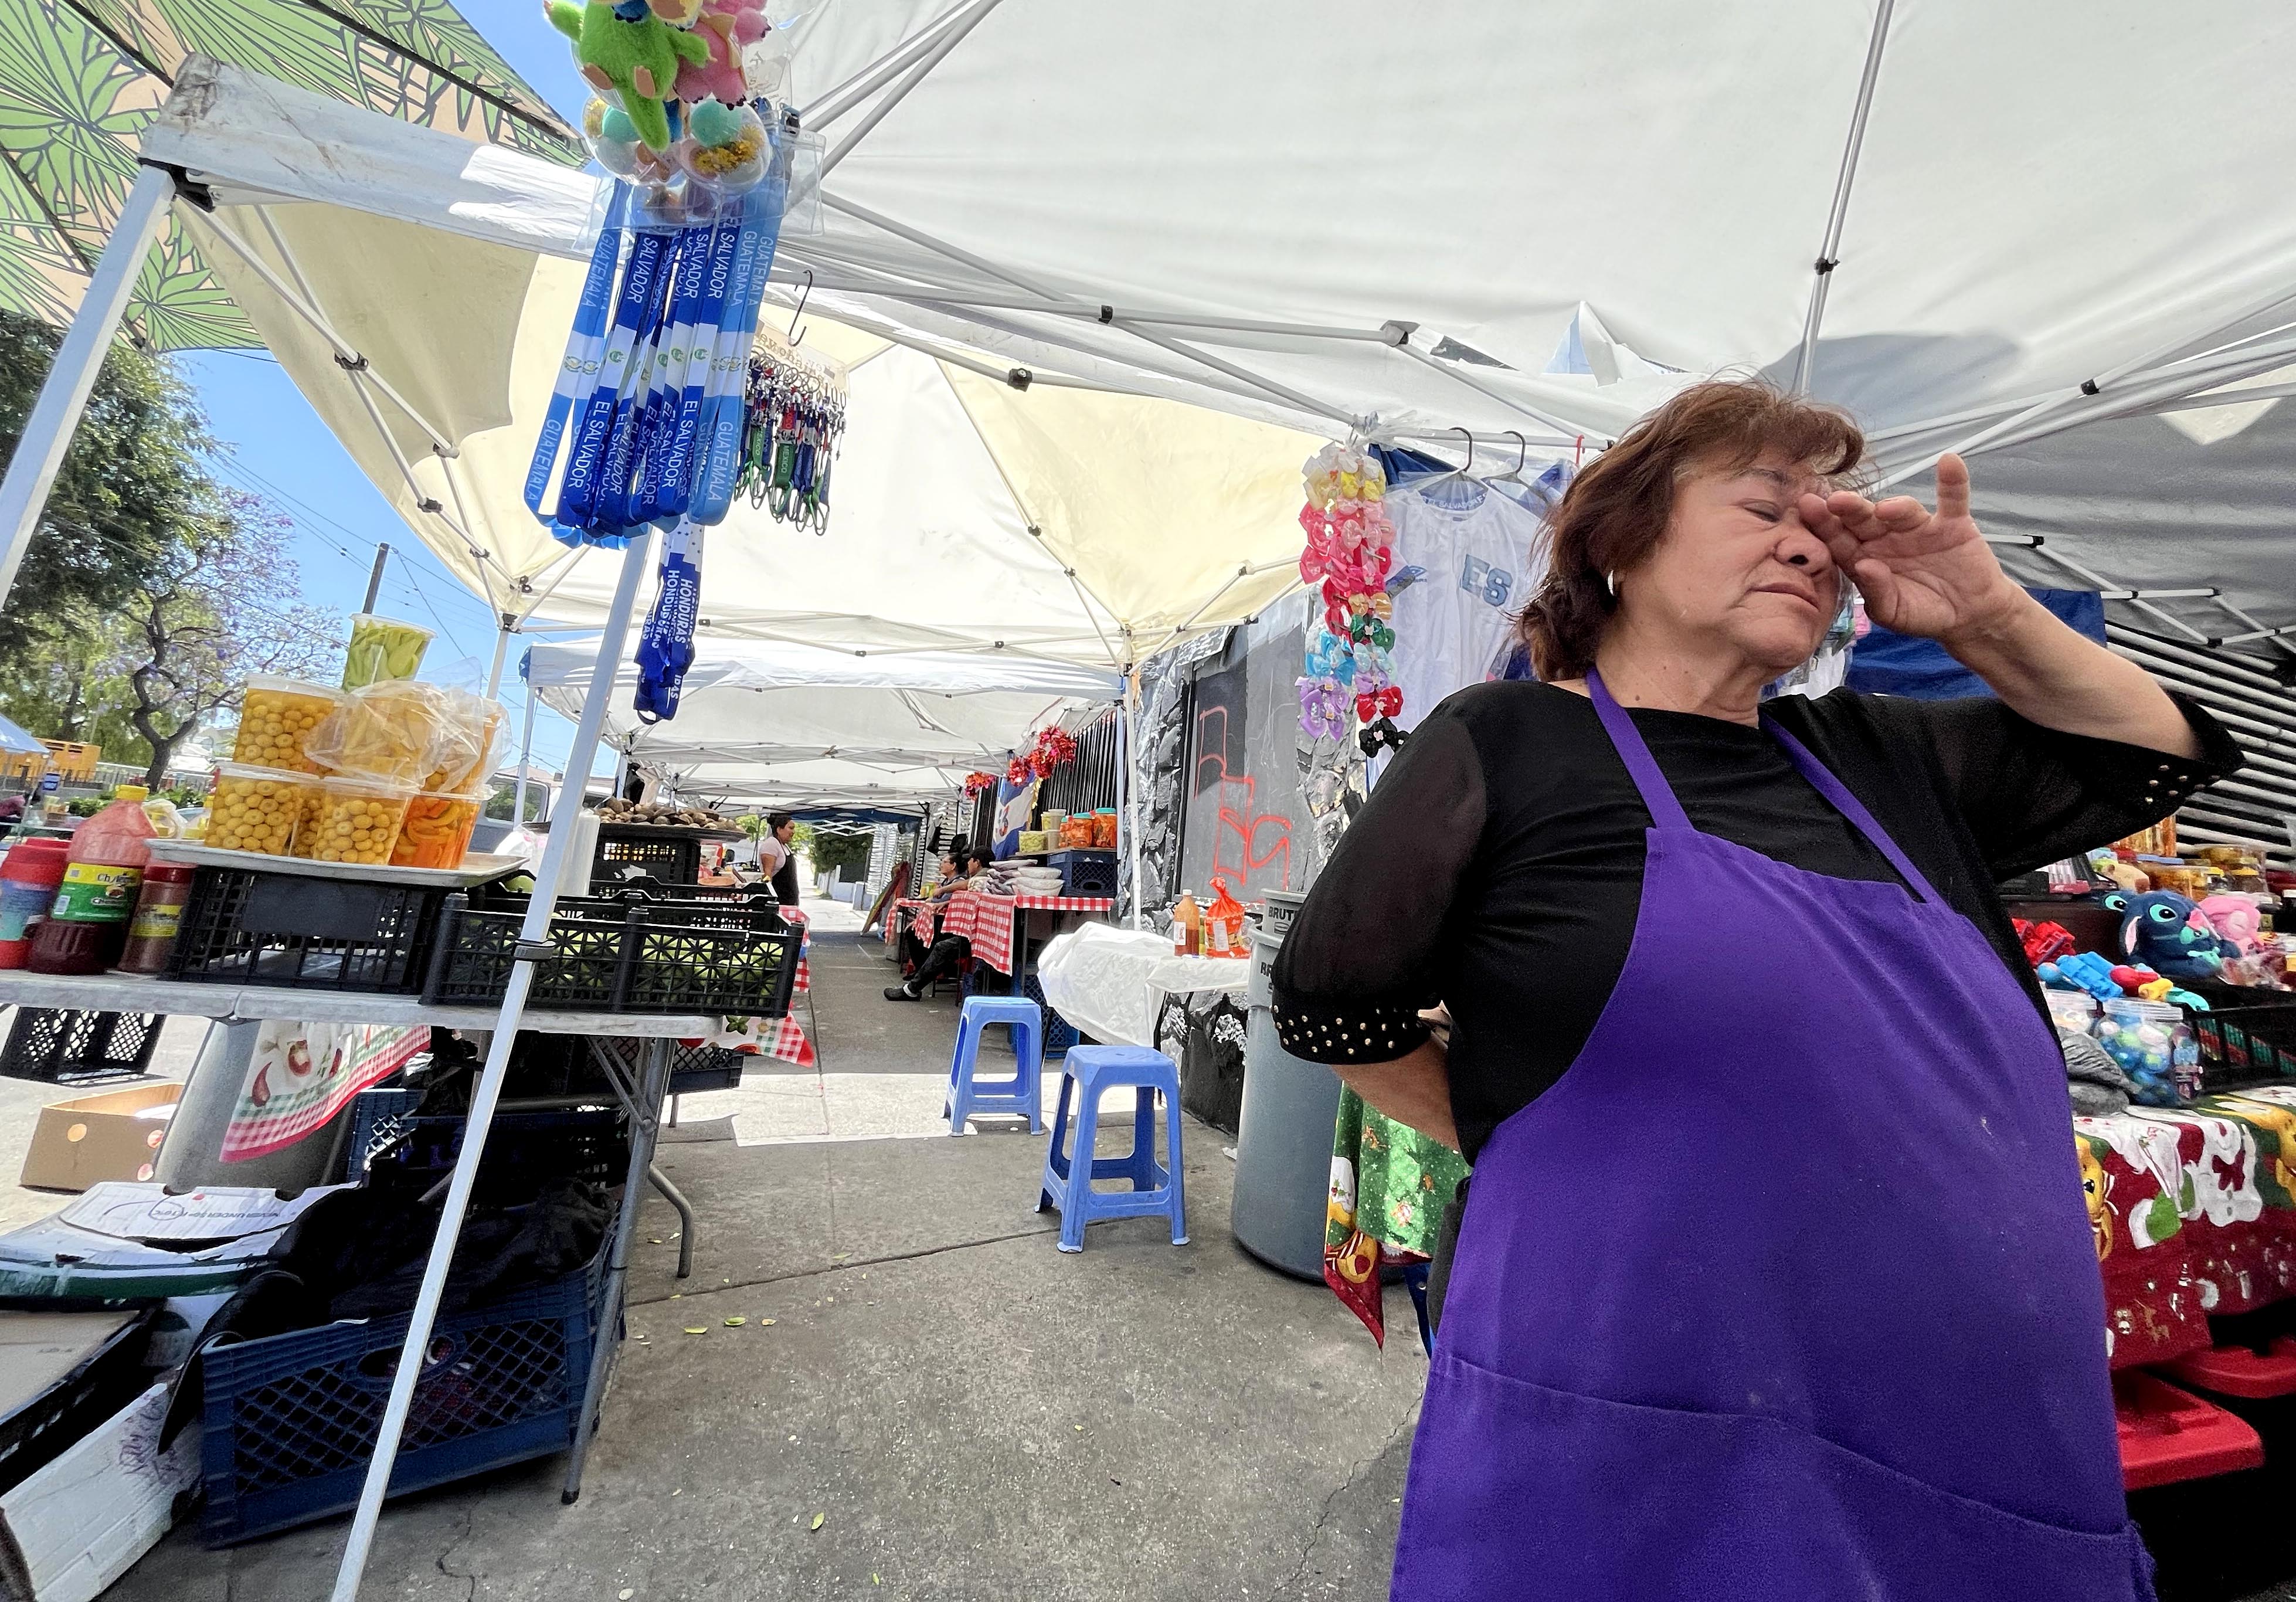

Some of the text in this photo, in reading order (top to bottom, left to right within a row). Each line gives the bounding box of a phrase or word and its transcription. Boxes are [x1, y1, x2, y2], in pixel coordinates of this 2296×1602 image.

[582, 234, 615, 307] GUATEMALA
[627, 237, 658, 304] SALVADOR
[683, 234, 708, 298] SALVADOR
[708, 232, 735, 299] SALVADOR
[730, 230, 758, 307] GUATEMALA
[684, 400, 697, 417] EL
[527, 419, 562, 501] GUATEMALA
[568, 400, 610, 488] EL SALVADOR
[662, 419, 692, 488] SALVADOR
[708, 421, 733, 501] GUATEMALA
[780, 445, 789, 473] MEXICO
[675, 578, 692, 644] HONDURAS
[1462, 554, 1513, 606] ES
[1269, 906, 1295, 921] BRUT
